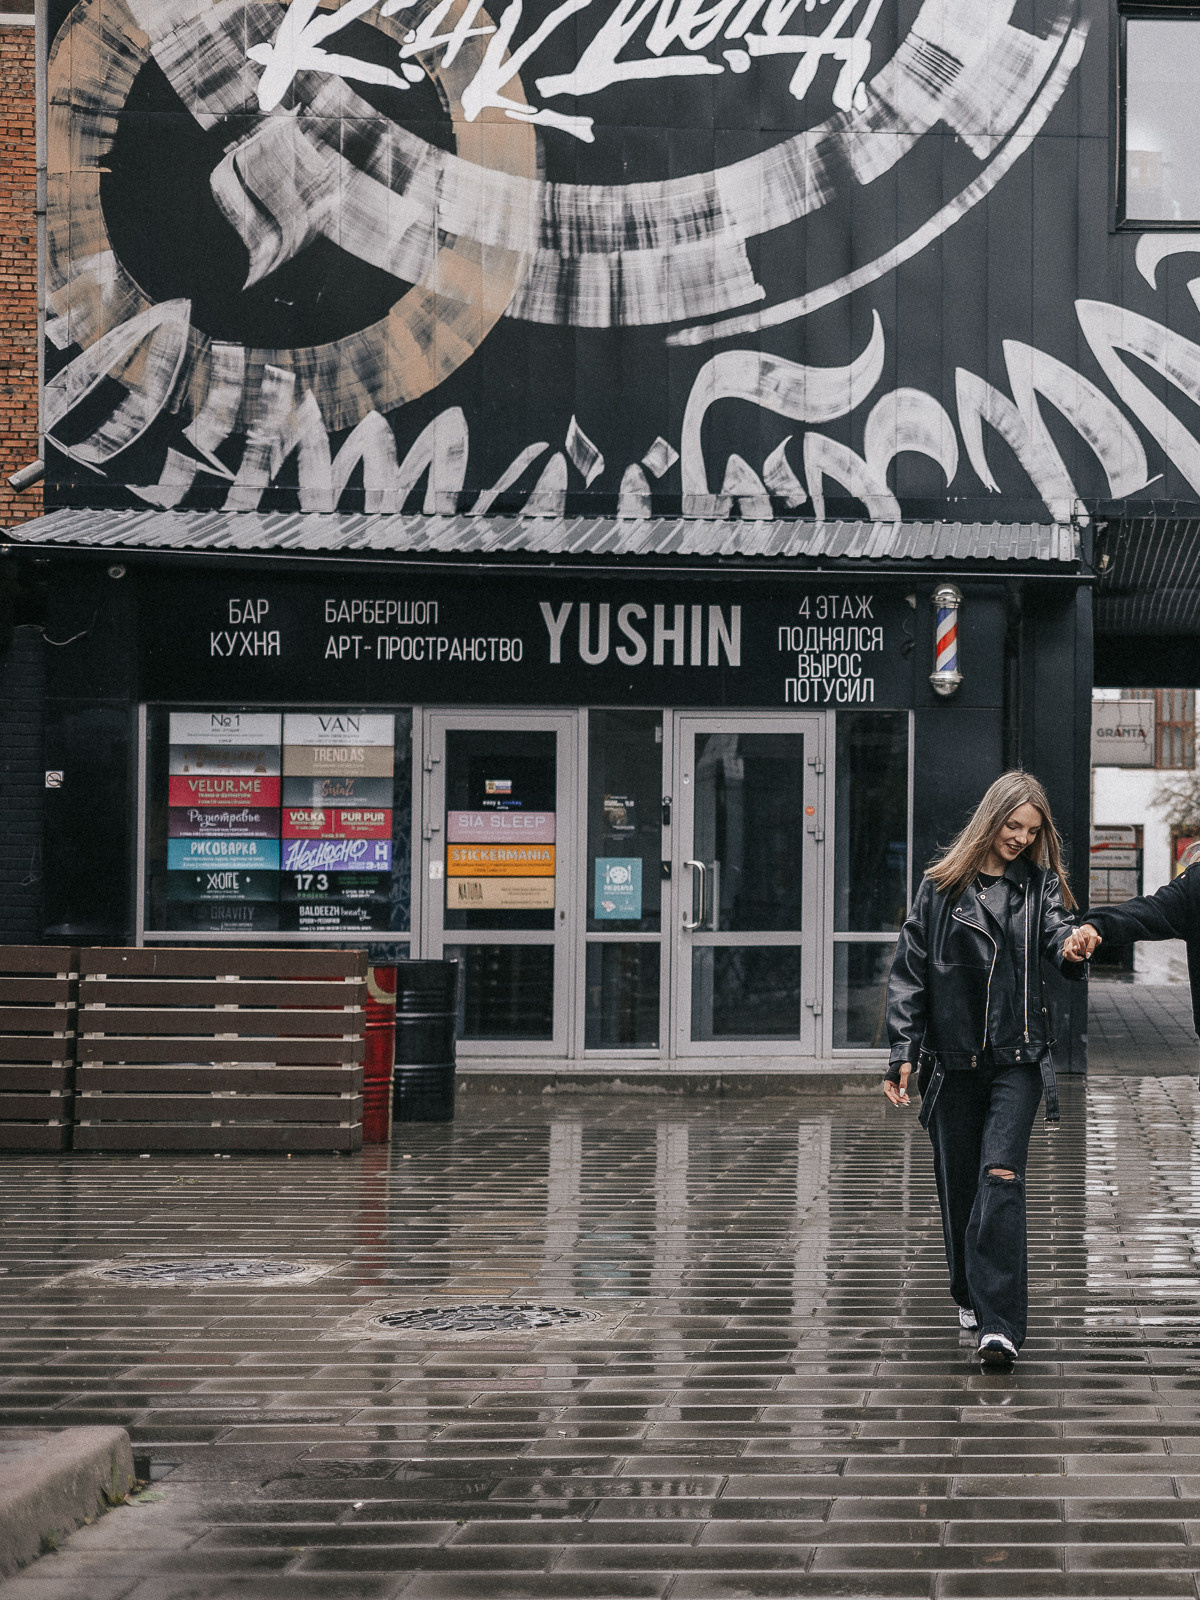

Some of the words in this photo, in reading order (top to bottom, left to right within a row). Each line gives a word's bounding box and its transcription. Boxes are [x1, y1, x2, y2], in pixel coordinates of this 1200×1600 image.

[229, 599, 269, 624] БАР
[325, 600, 438, 625] БАРБЕРШОП
[798, 595, 811, 619] 4
[816, 595, 874, 620] ЭТАЖ
[210, 630, 281, 657] КУХНЯ
[539, 602, 742, 667] YUSHIN
[778, 626, 884, 654] ПОДНЯЛСЯ
[798, 653, 862, 678] ВЫРОС
[785, 678, 875, 702] ПОТУСИЛ
[318, 716, 360, 732] VAN
[1096, 728, 1147, 738] GRANTA
[188, 779, 261, 793] VELUR.ME
[490, 815, 546, 828] SLEEP
[190, 841, 257, 856] РИСОВАРКА
[452, 849, 551, 861] STICKERMANIA
